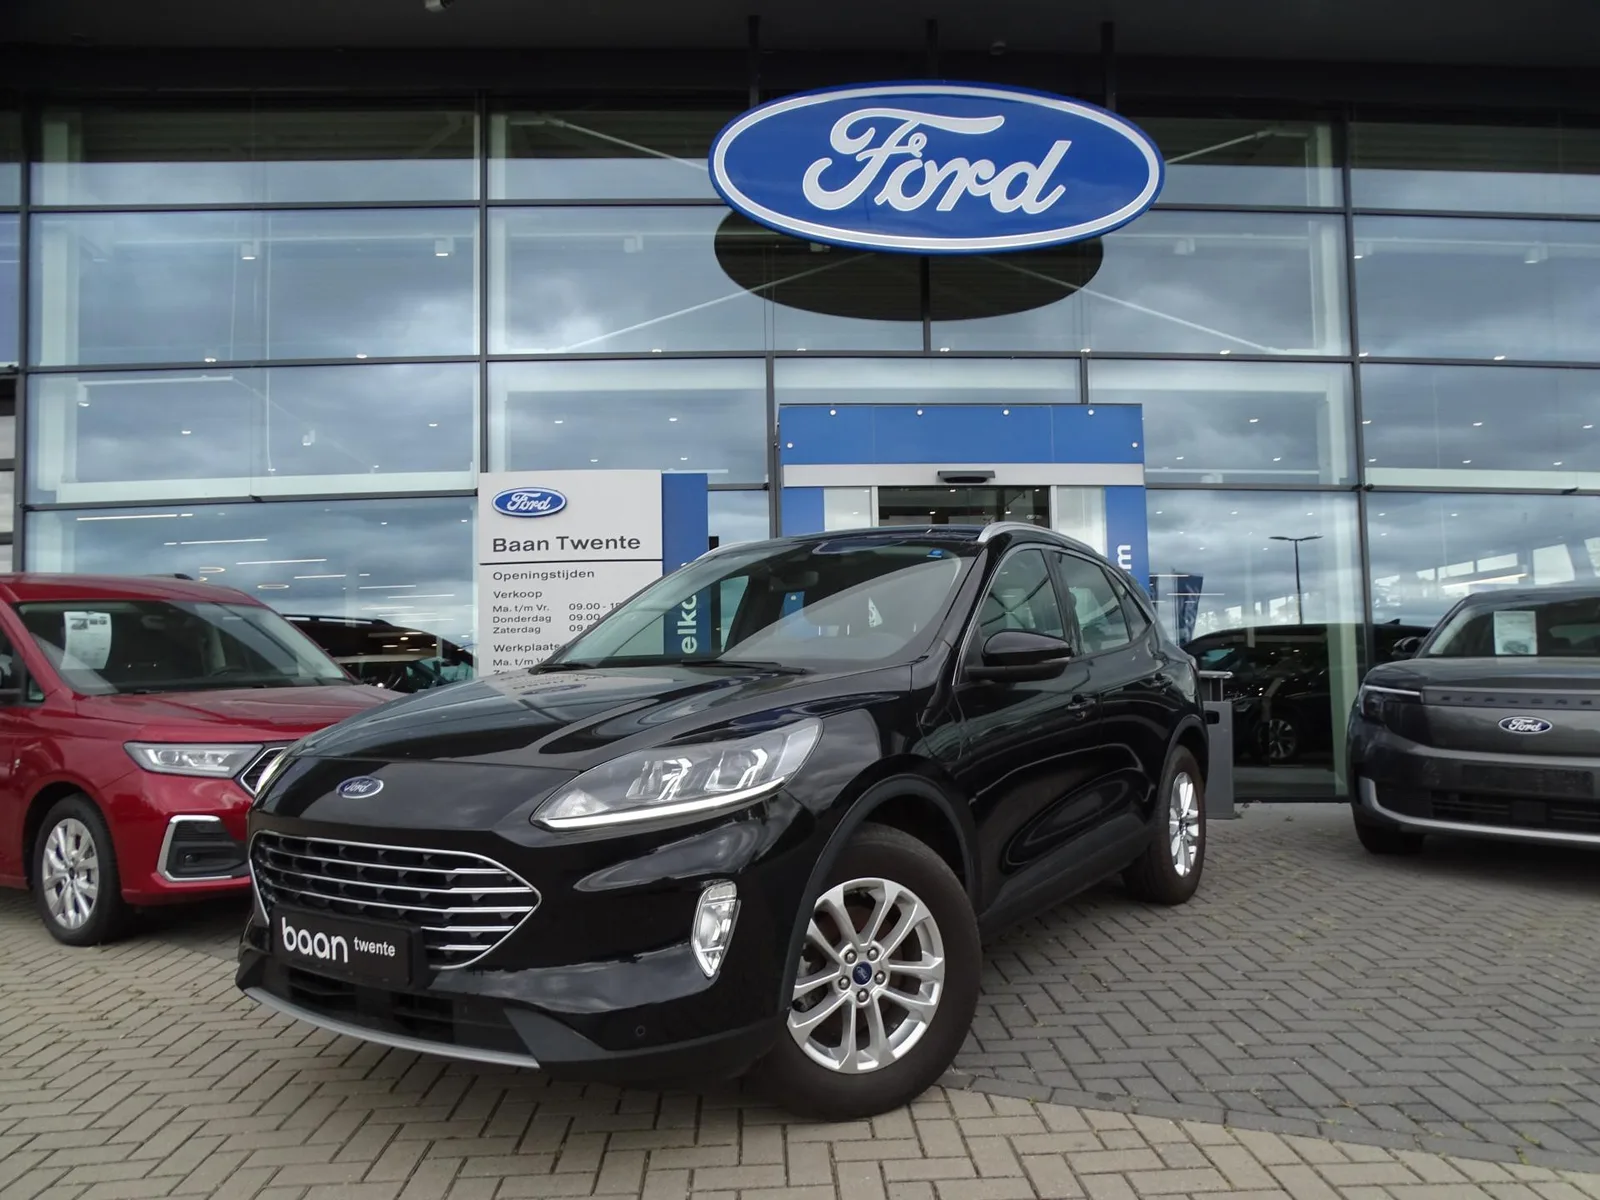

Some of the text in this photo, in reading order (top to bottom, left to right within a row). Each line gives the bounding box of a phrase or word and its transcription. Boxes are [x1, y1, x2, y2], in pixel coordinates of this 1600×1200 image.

[803, 107, 1072, 214] Ford
[506, 492, 551, 511] Ford
[492, 535, 641, 553] Baan Twente
[492, 570, 595, 582] Openingstijden
[493, 590, 543, 599] Verkoop
[492, 605, 512, 613] Ma.
[514, 604, 533, 612] t/m
[492, 613, 601, 624] Donderdag 09.00
[492, 626, 541, 634] Zaterdag
[493, 643, 561, 653] Werkplaats
[492, 658, 512, 666] Ma.
[514, 658, 534, 666] t/m
[1508, 718, 1542, 732] Ford
[282, 916, 396, 963] baan twente
